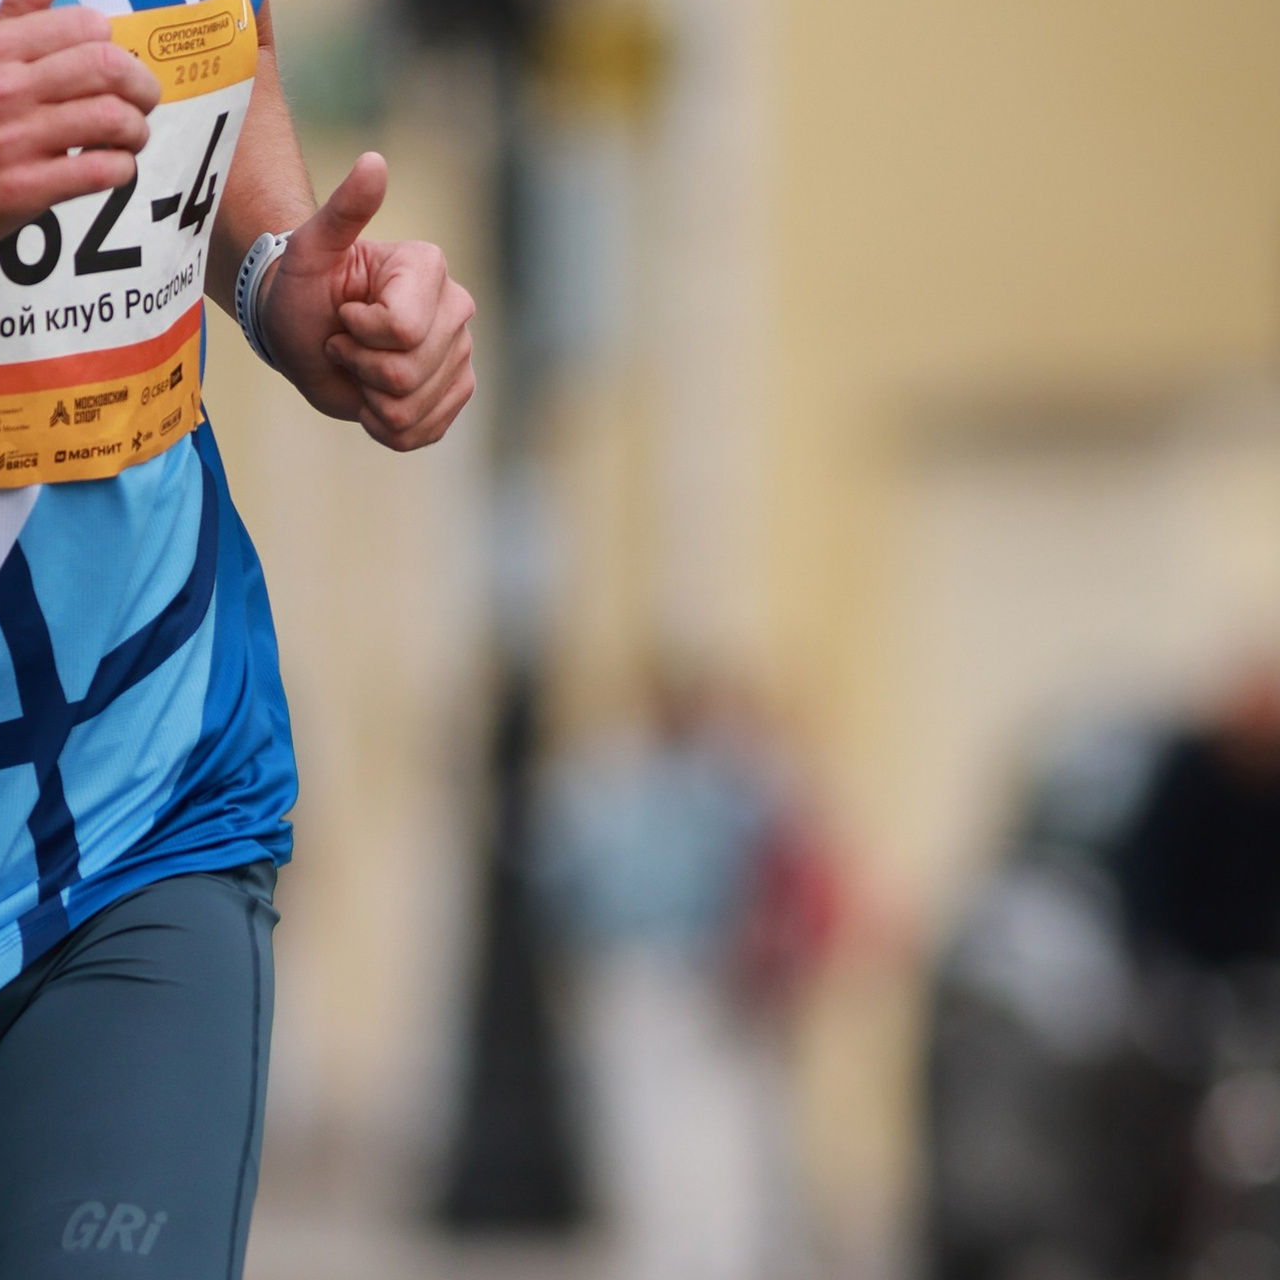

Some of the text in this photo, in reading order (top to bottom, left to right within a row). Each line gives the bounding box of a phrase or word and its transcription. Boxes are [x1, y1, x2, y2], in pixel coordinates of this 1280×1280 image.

[159, 37, 206, 56] ЭСТАФЕТА
[174, 55, 221, 86] 2026
[45, 292, 115, 333] клуб
[125, 262, 194, 319] Росатома
[74, 386, 129, 411] МОСКОВСКИЙ
[74, 408, 102, 425] СПОРТ
[6, 457, 38, 471] BRICS
